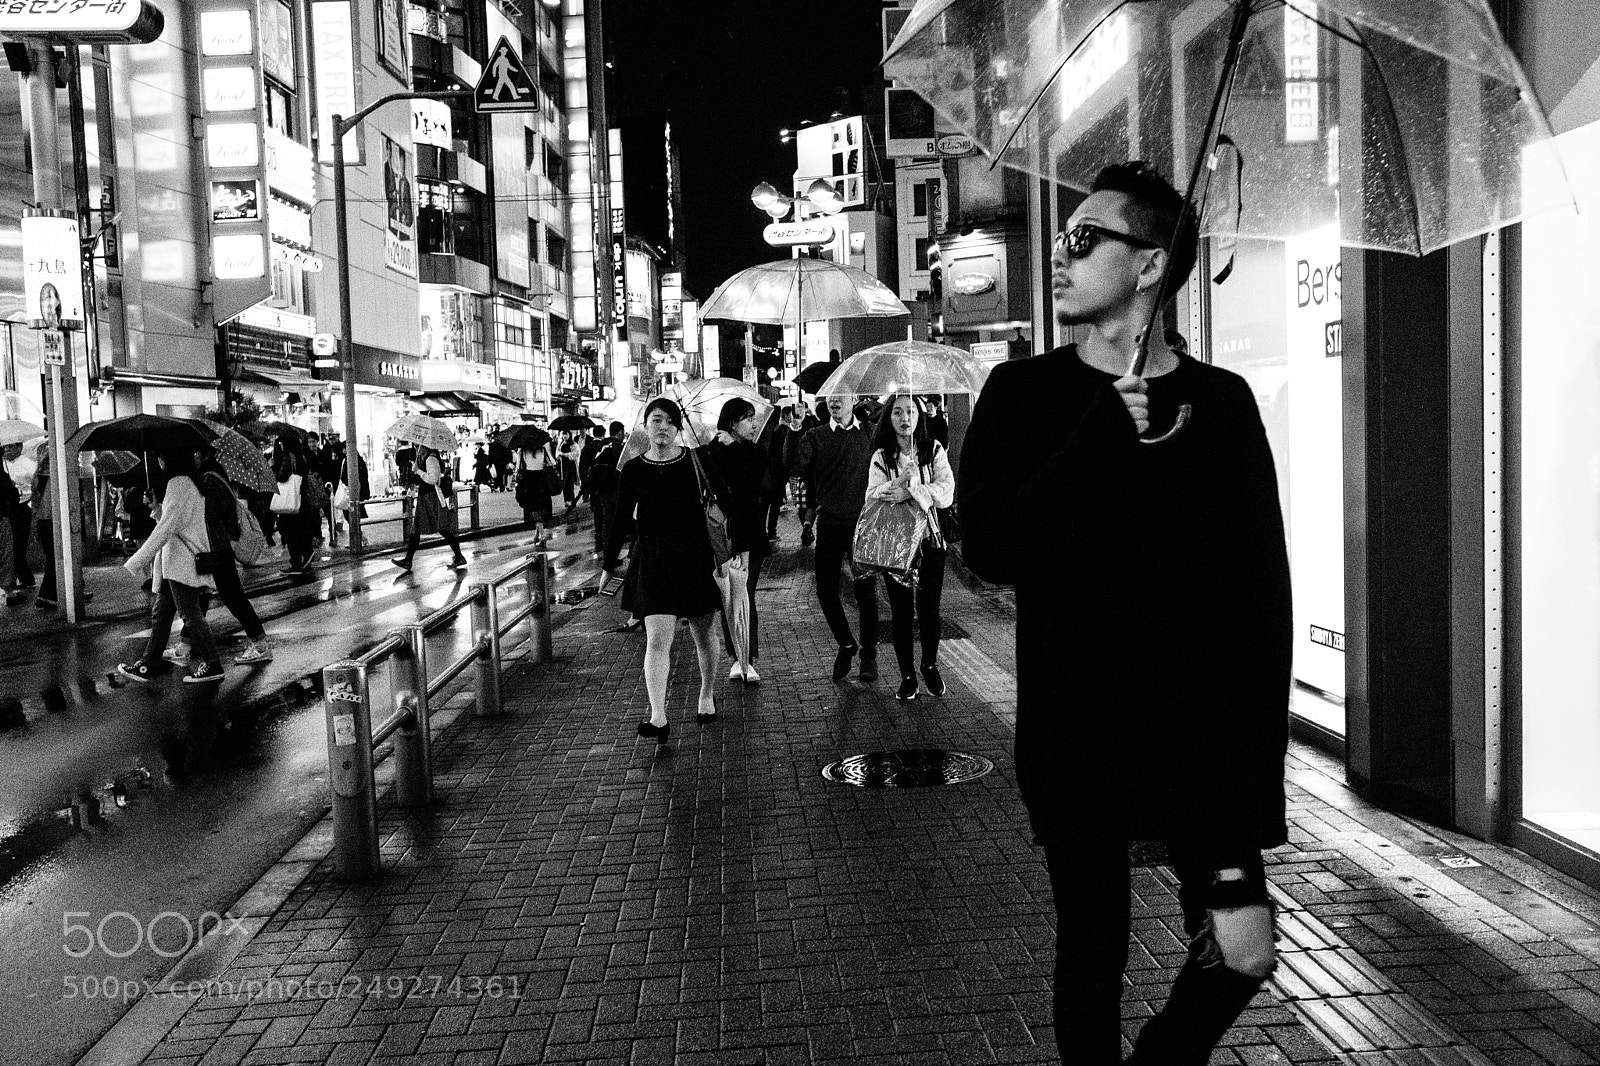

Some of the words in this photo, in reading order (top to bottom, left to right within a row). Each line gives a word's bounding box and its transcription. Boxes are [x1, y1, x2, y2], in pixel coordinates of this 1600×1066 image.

[0, 0, 126, 14] 谷センター街
[321, 16, 346, 62] TAX
